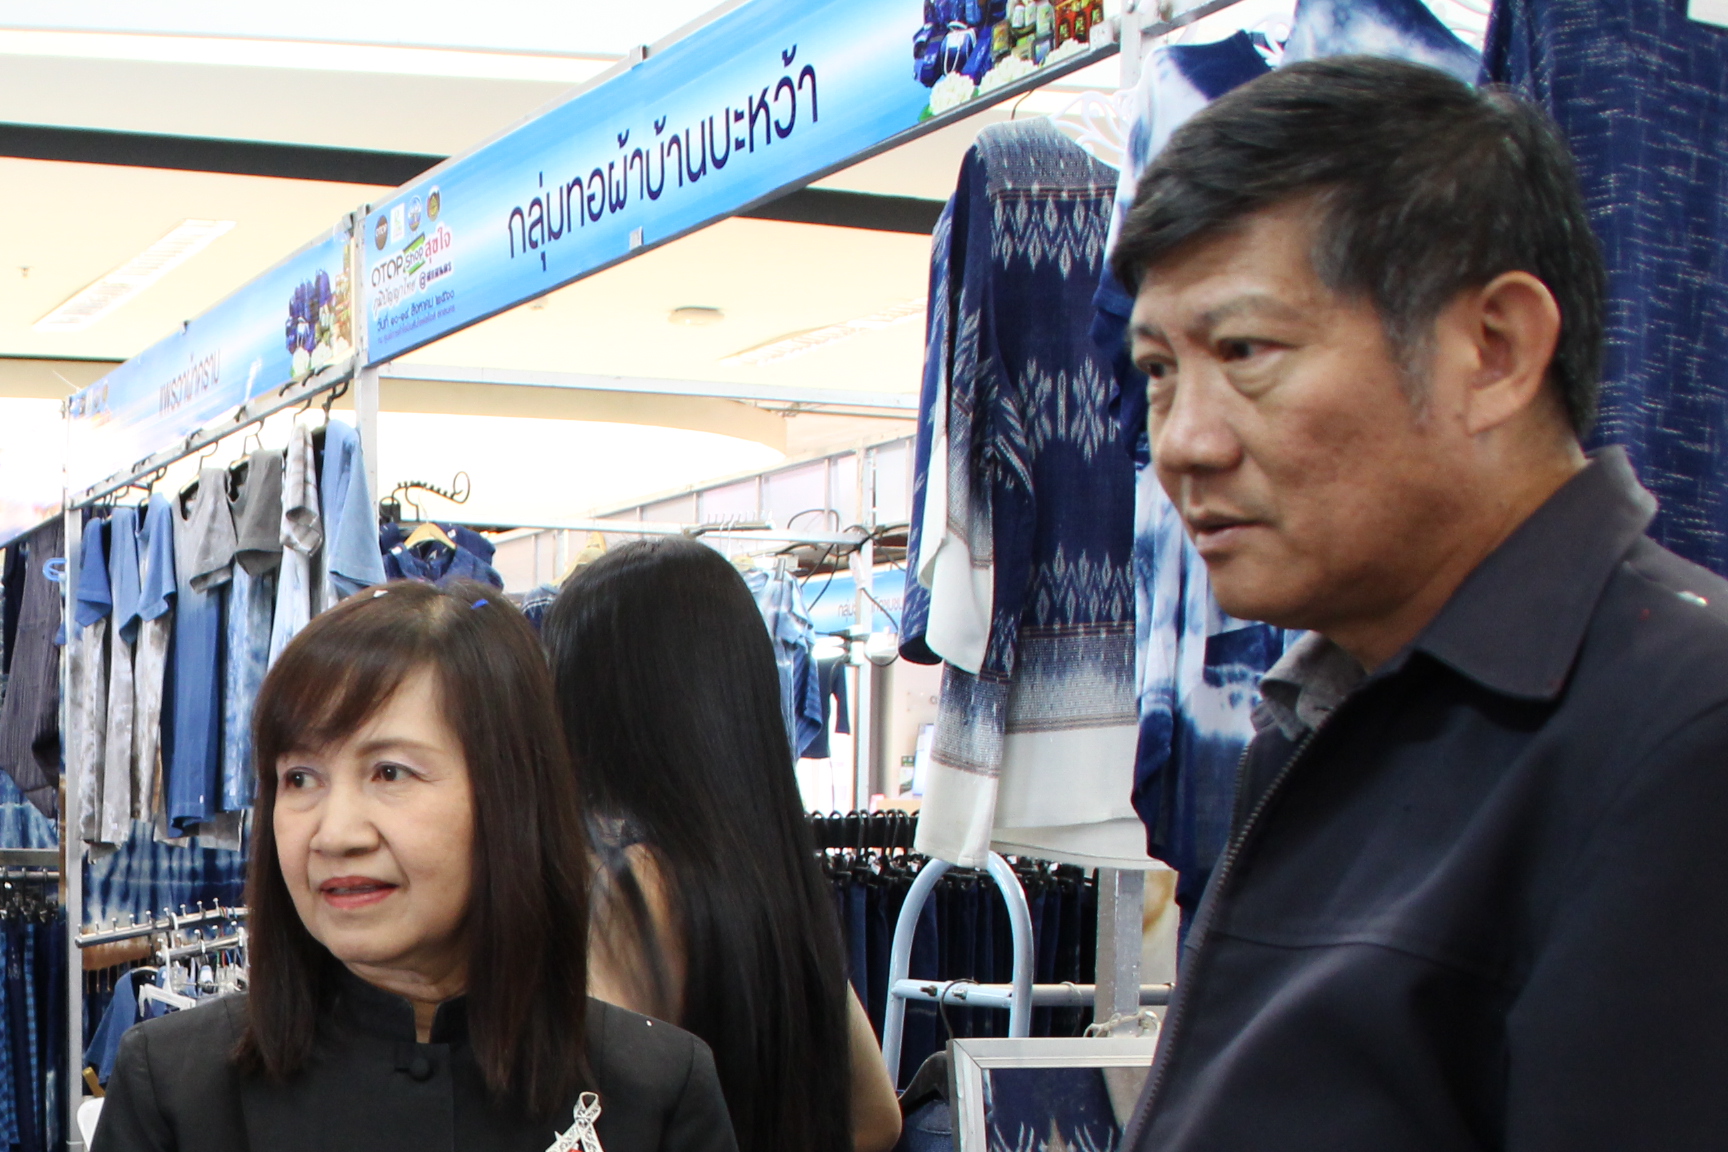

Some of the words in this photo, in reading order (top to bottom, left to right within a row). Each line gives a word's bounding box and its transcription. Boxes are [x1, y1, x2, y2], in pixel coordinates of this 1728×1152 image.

[508, 44, 819, 273] กลุ่มทอผ้าบ้านบะหว้า
[371, 255, 404, 288] OTOP
